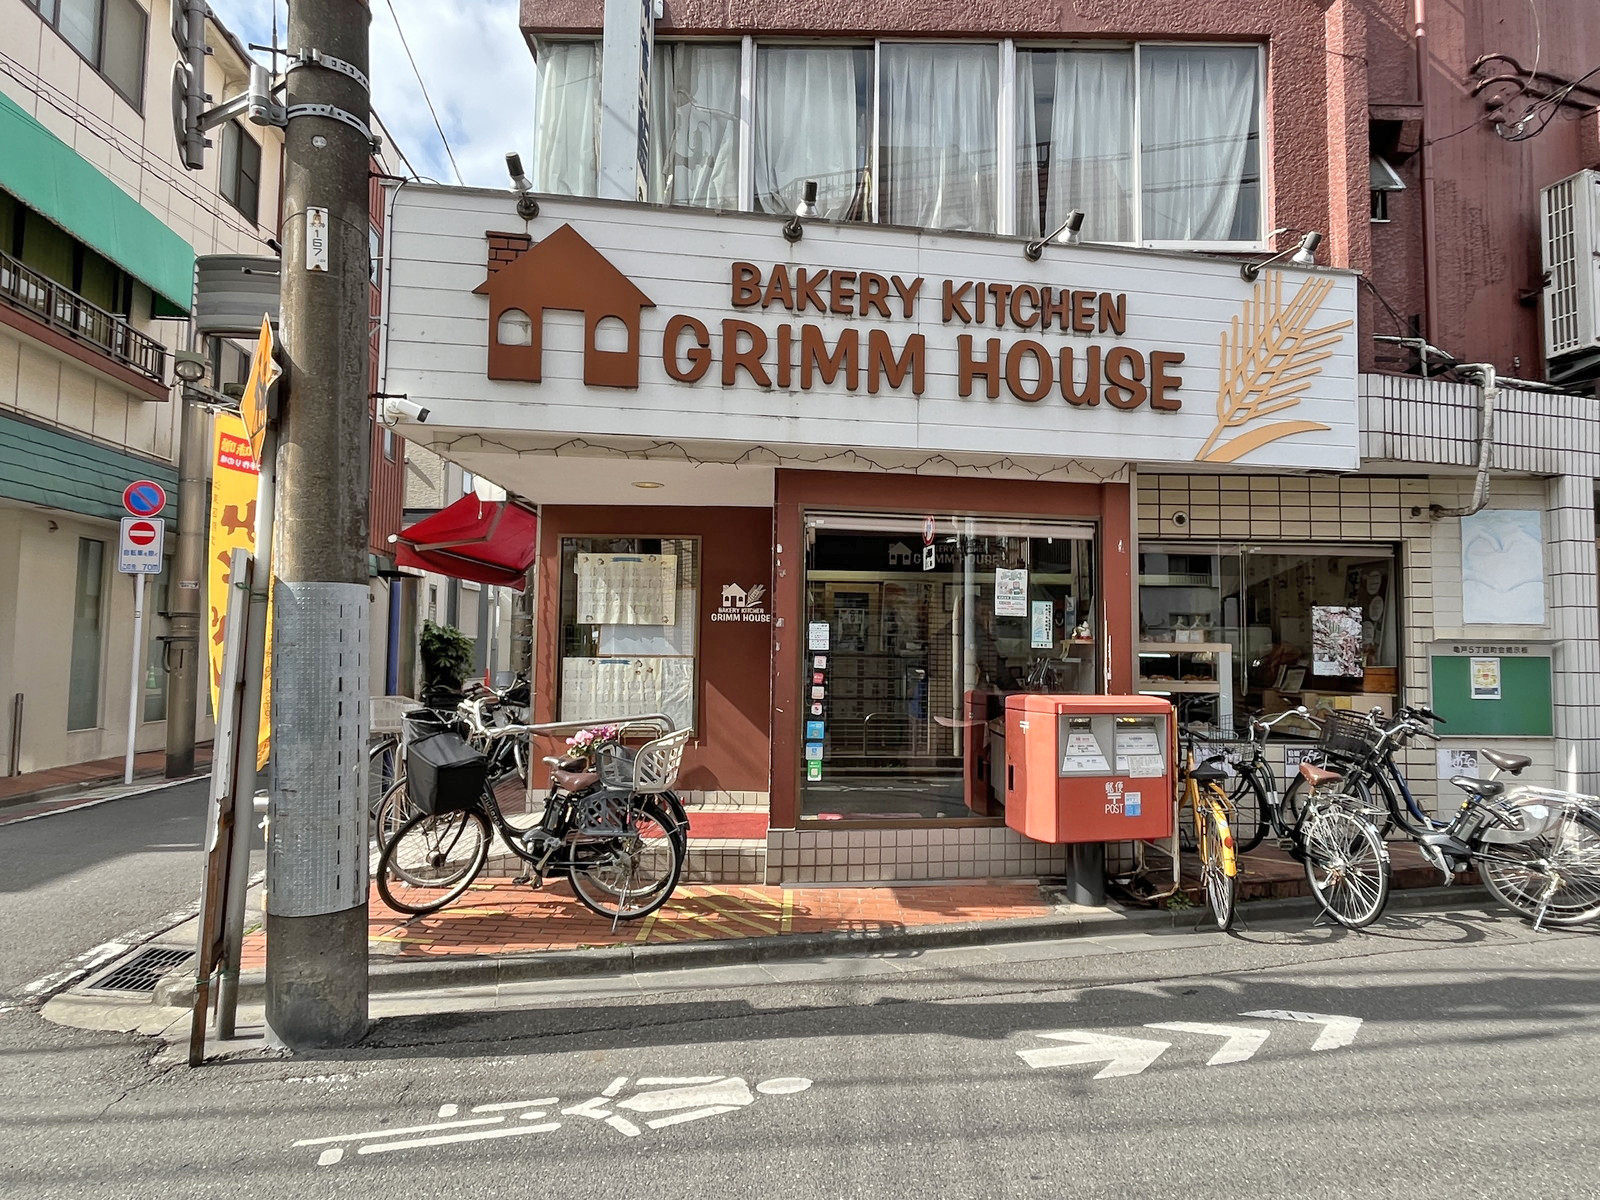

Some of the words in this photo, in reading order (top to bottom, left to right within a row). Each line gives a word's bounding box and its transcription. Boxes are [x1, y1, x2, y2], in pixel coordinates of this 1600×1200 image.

[732, 262, 924, 318] BAKERY
[942, 280, 1127, 335] KITCHEN
[663, 314, 925, 395] GRIMM
[957, 334, 1185, 411] HOUSE
[711, 613, 741, 622] GRIMM
[742, 614, 771, 623] HOUSE
[1104, 781, 1123, 793] 郵便
[1104, 803, 1124, 814] POST
